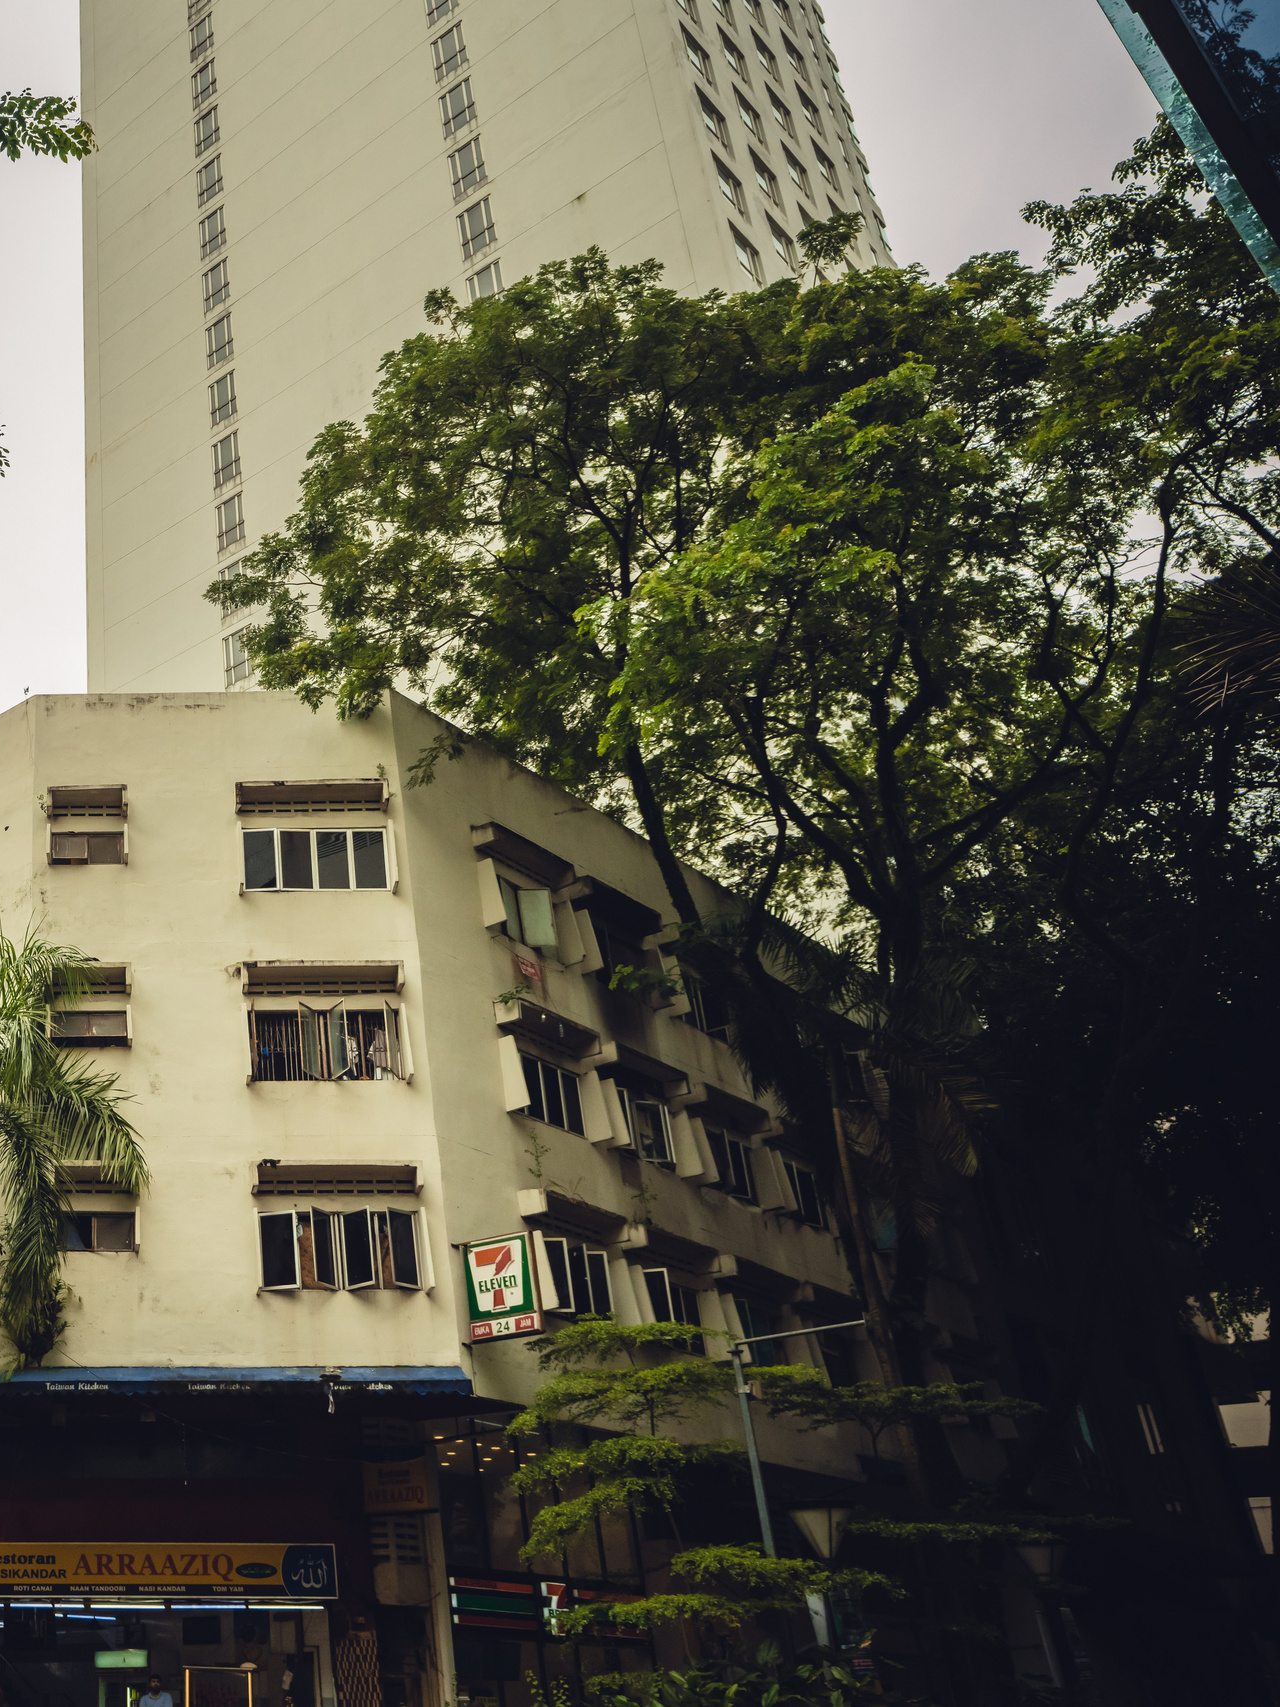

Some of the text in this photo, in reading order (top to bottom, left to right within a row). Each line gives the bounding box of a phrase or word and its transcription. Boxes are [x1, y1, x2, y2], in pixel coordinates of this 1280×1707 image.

[474, 1244, 513, 1310] 7
[474, 1318, 532, 1335] BUKA 24 JAM
[45, 1381, 109, 1391] Taiwan Kitchen
[72, 1553, 234, 1582] ARRAAZIQ
